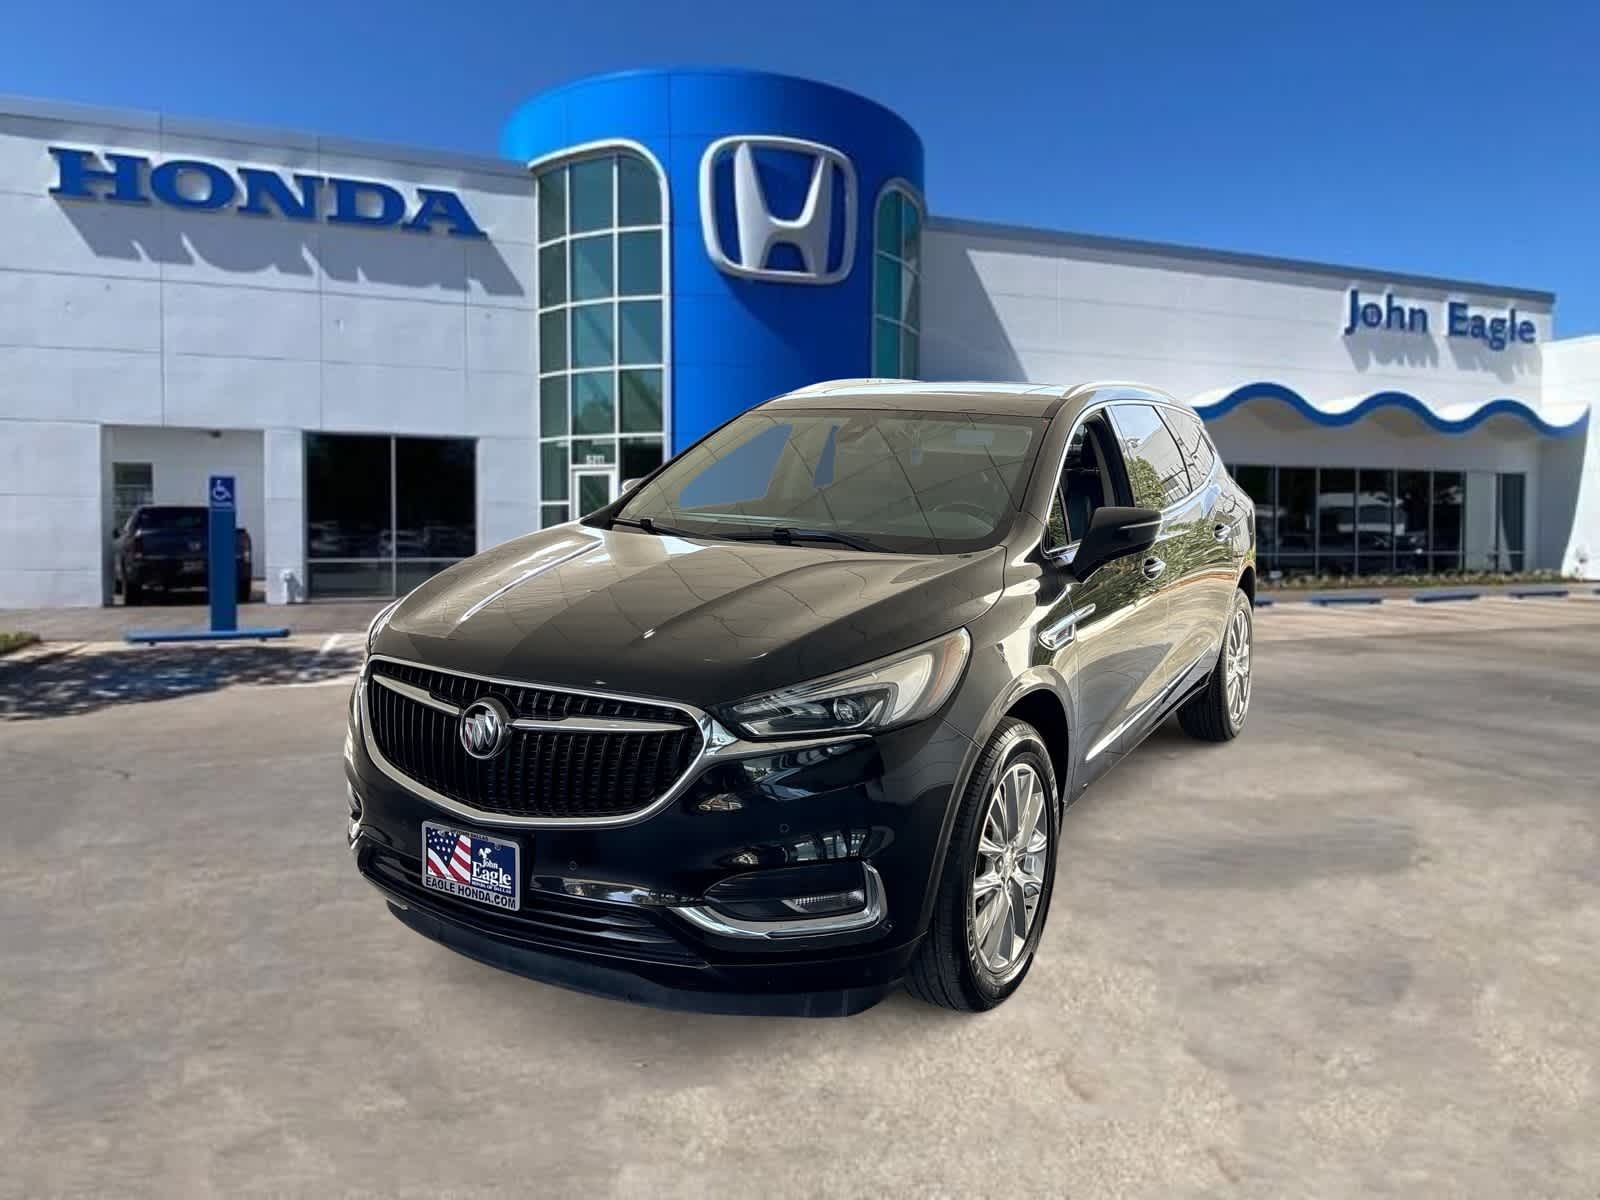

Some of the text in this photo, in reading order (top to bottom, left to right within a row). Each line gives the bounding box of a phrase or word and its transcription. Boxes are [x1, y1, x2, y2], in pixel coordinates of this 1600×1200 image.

[48, 146, 488, 239] HONDA
[1344, 288, 1536, 352] John Eagle
[472, 861, 512, 886] Eagle
[481, 858, 498, 869] John
[425, 876, 516, 909] EAGLE HONDA.COM
